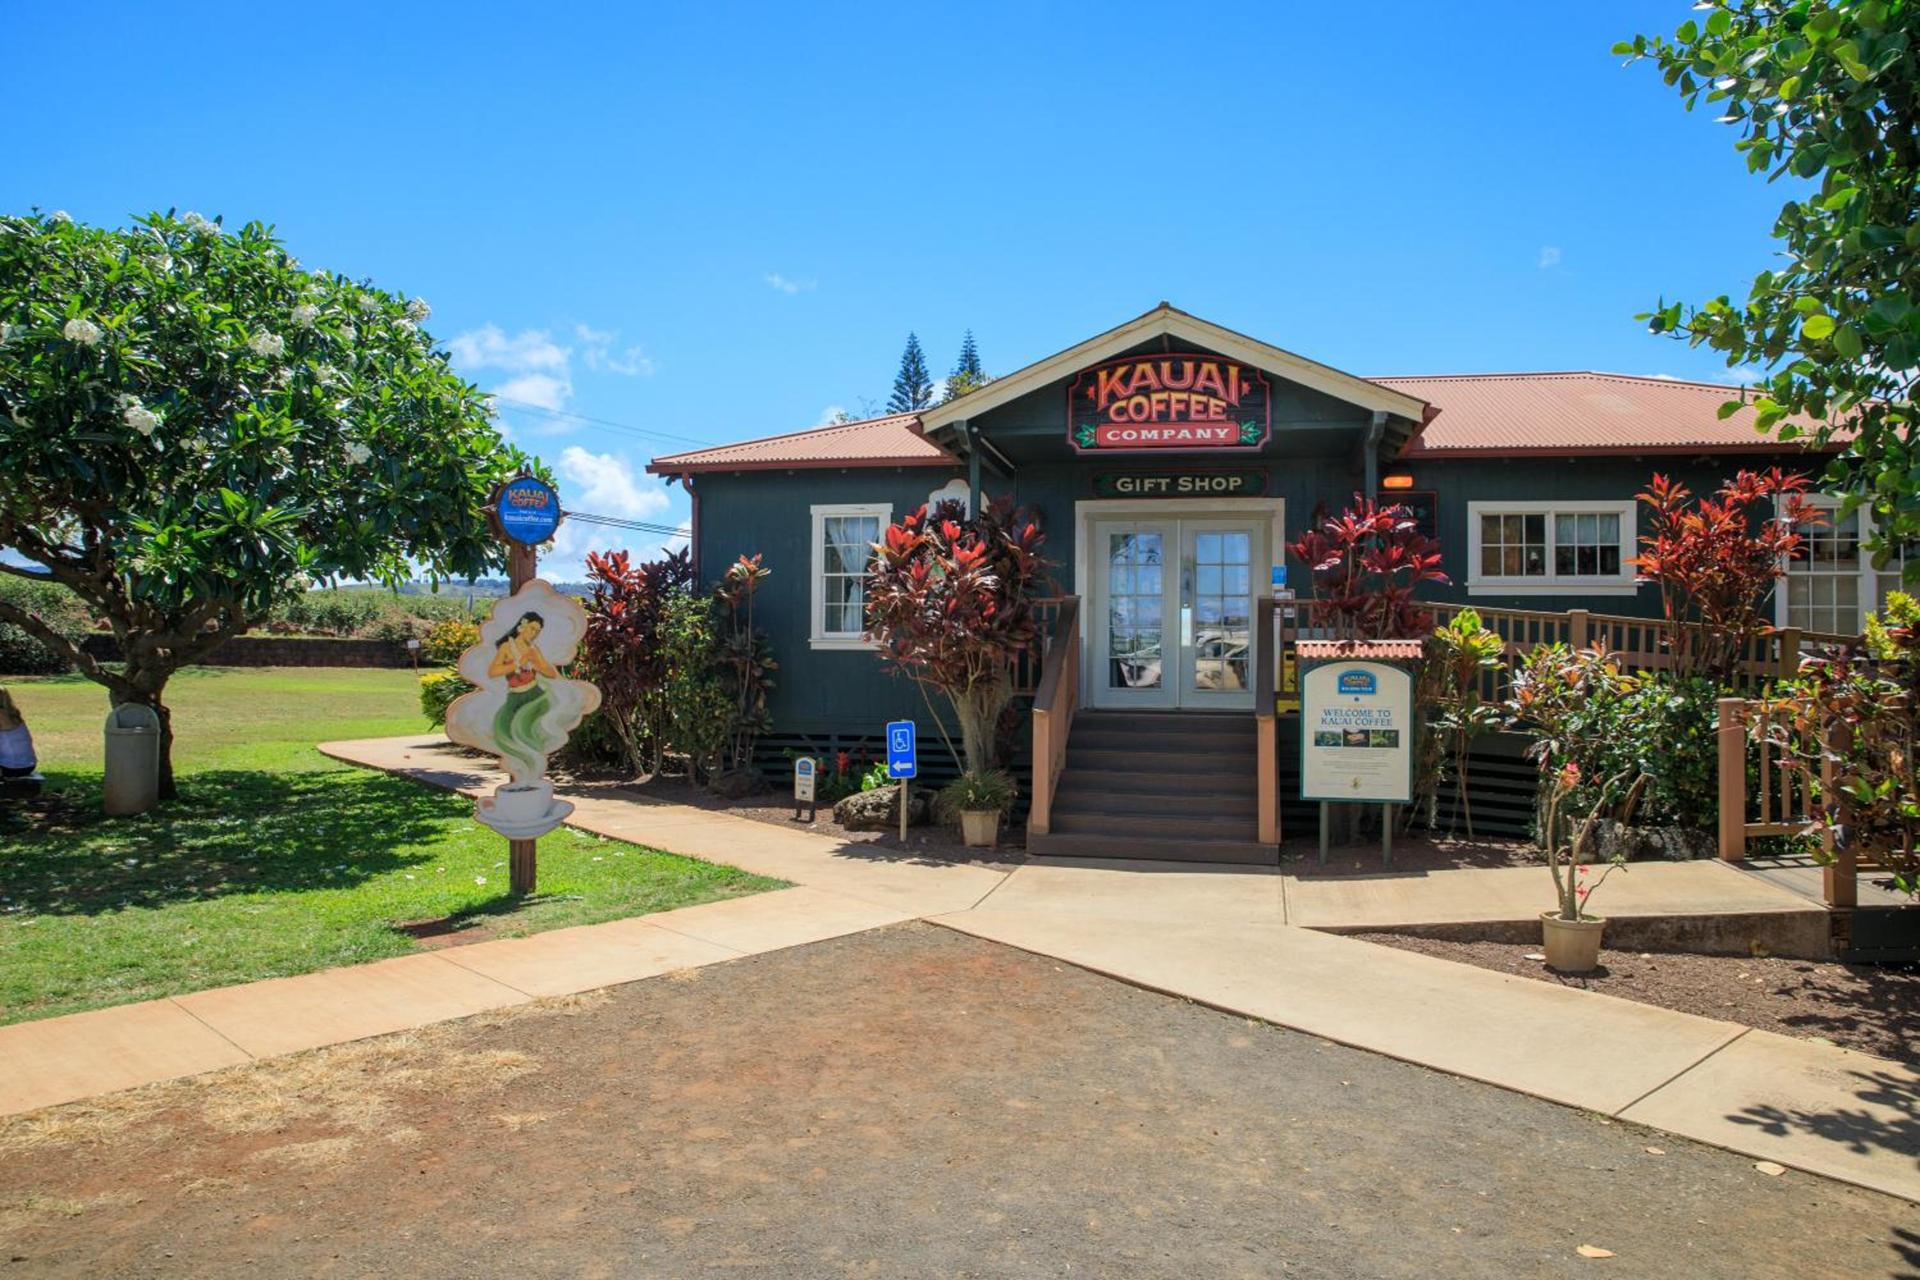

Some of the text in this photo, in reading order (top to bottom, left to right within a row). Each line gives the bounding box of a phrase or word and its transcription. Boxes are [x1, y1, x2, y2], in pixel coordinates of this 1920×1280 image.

[1096, 361, 1241, 411] KAUAI
[1109, 391, 1227, 422] COFFEE
[1106, 428, 1230, 441] COMPANY
[1116, 476, 1242, 492] GIFT SHOP
[1322, 709, 1391, 718] WELCOME TO
[1320, 717, 1393, 727] KAUAI COFFEE
